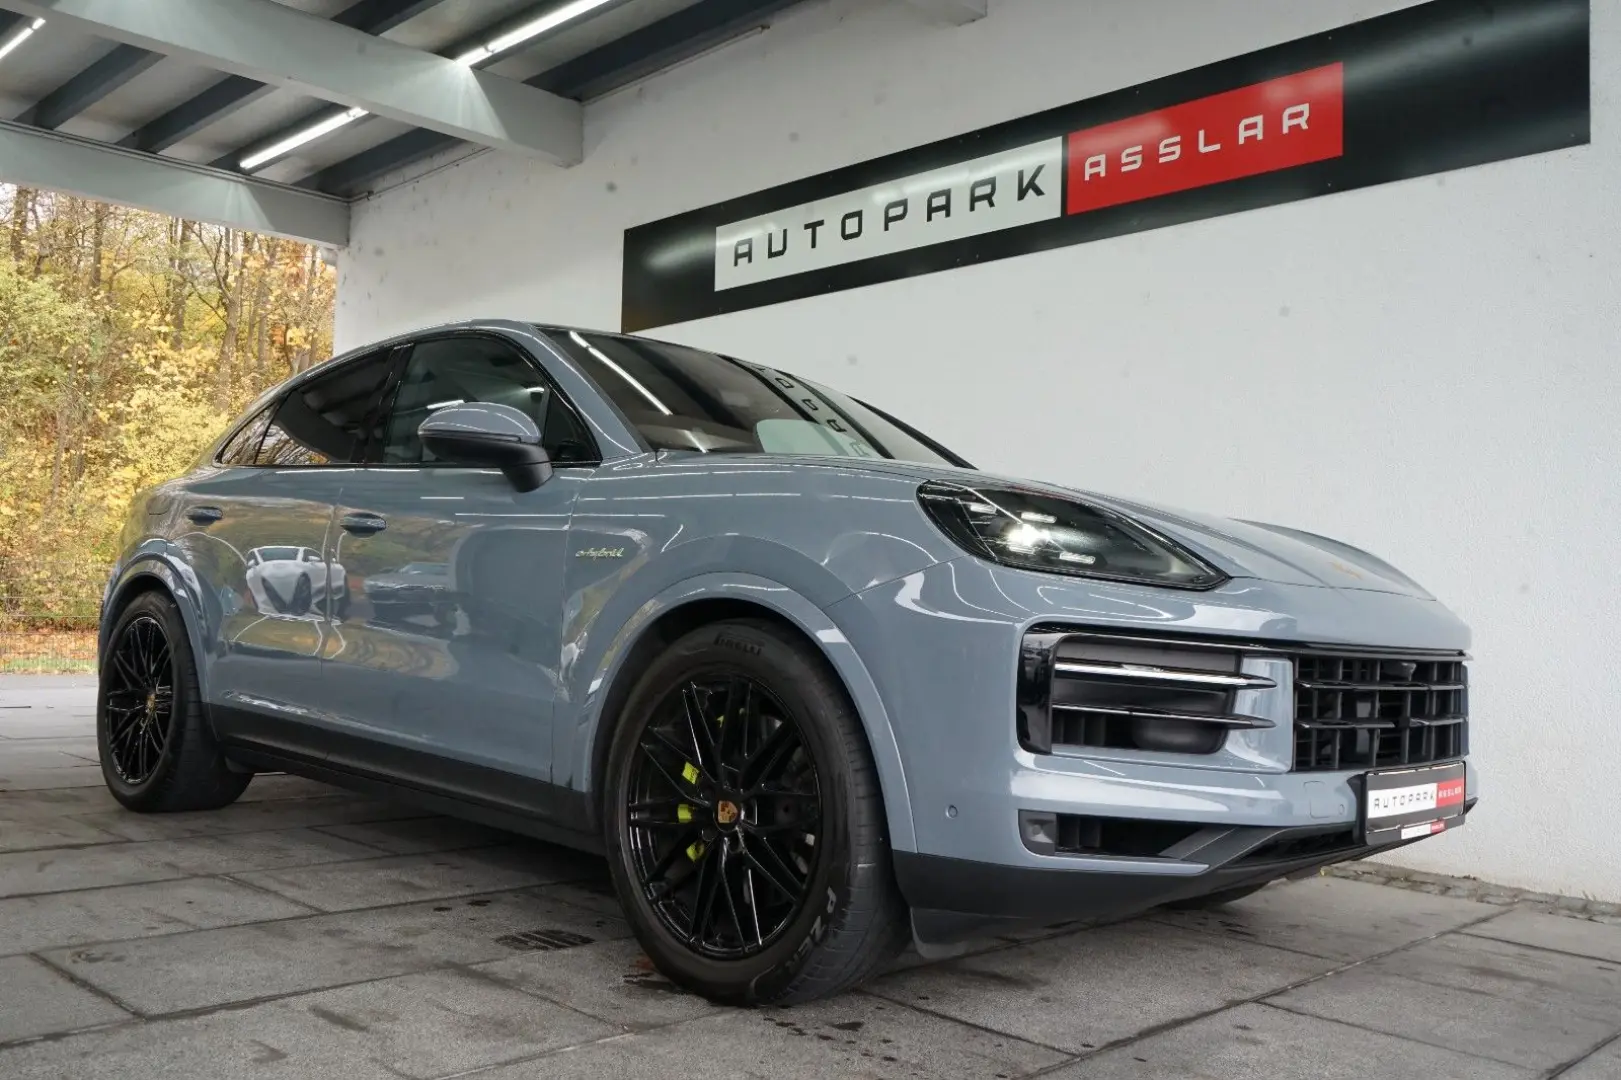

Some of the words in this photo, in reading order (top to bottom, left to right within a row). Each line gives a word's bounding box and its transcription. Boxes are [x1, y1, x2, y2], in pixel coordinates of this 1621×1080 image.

[733, 163, 1046, 267] AUTOPARK
[1084, 102, 1310, 182] ASSLAR
[1373, 790, 1435, 811] AUTOPARK
